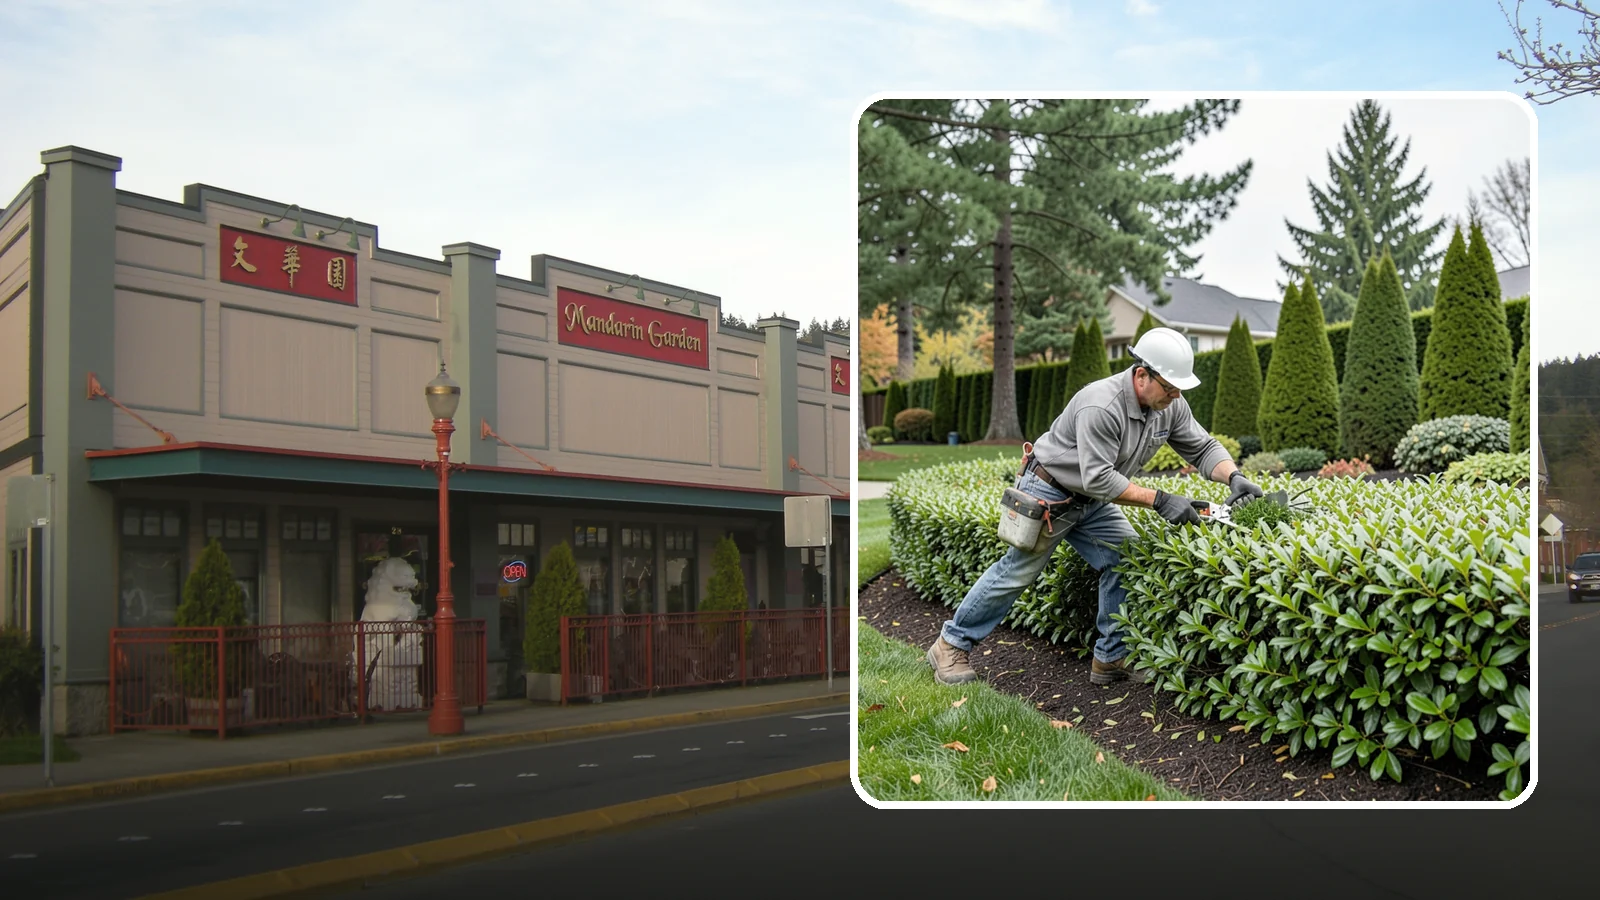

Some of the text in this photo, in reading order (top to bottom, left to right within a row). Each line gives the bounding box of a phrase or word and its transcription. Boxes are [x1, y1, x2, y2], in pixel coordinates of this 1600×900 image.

[230, 235, 346, 291] 文華園
[564, 302, 702, 352] Mandarin Garden
[503, 565, 527, 578] OPEN
